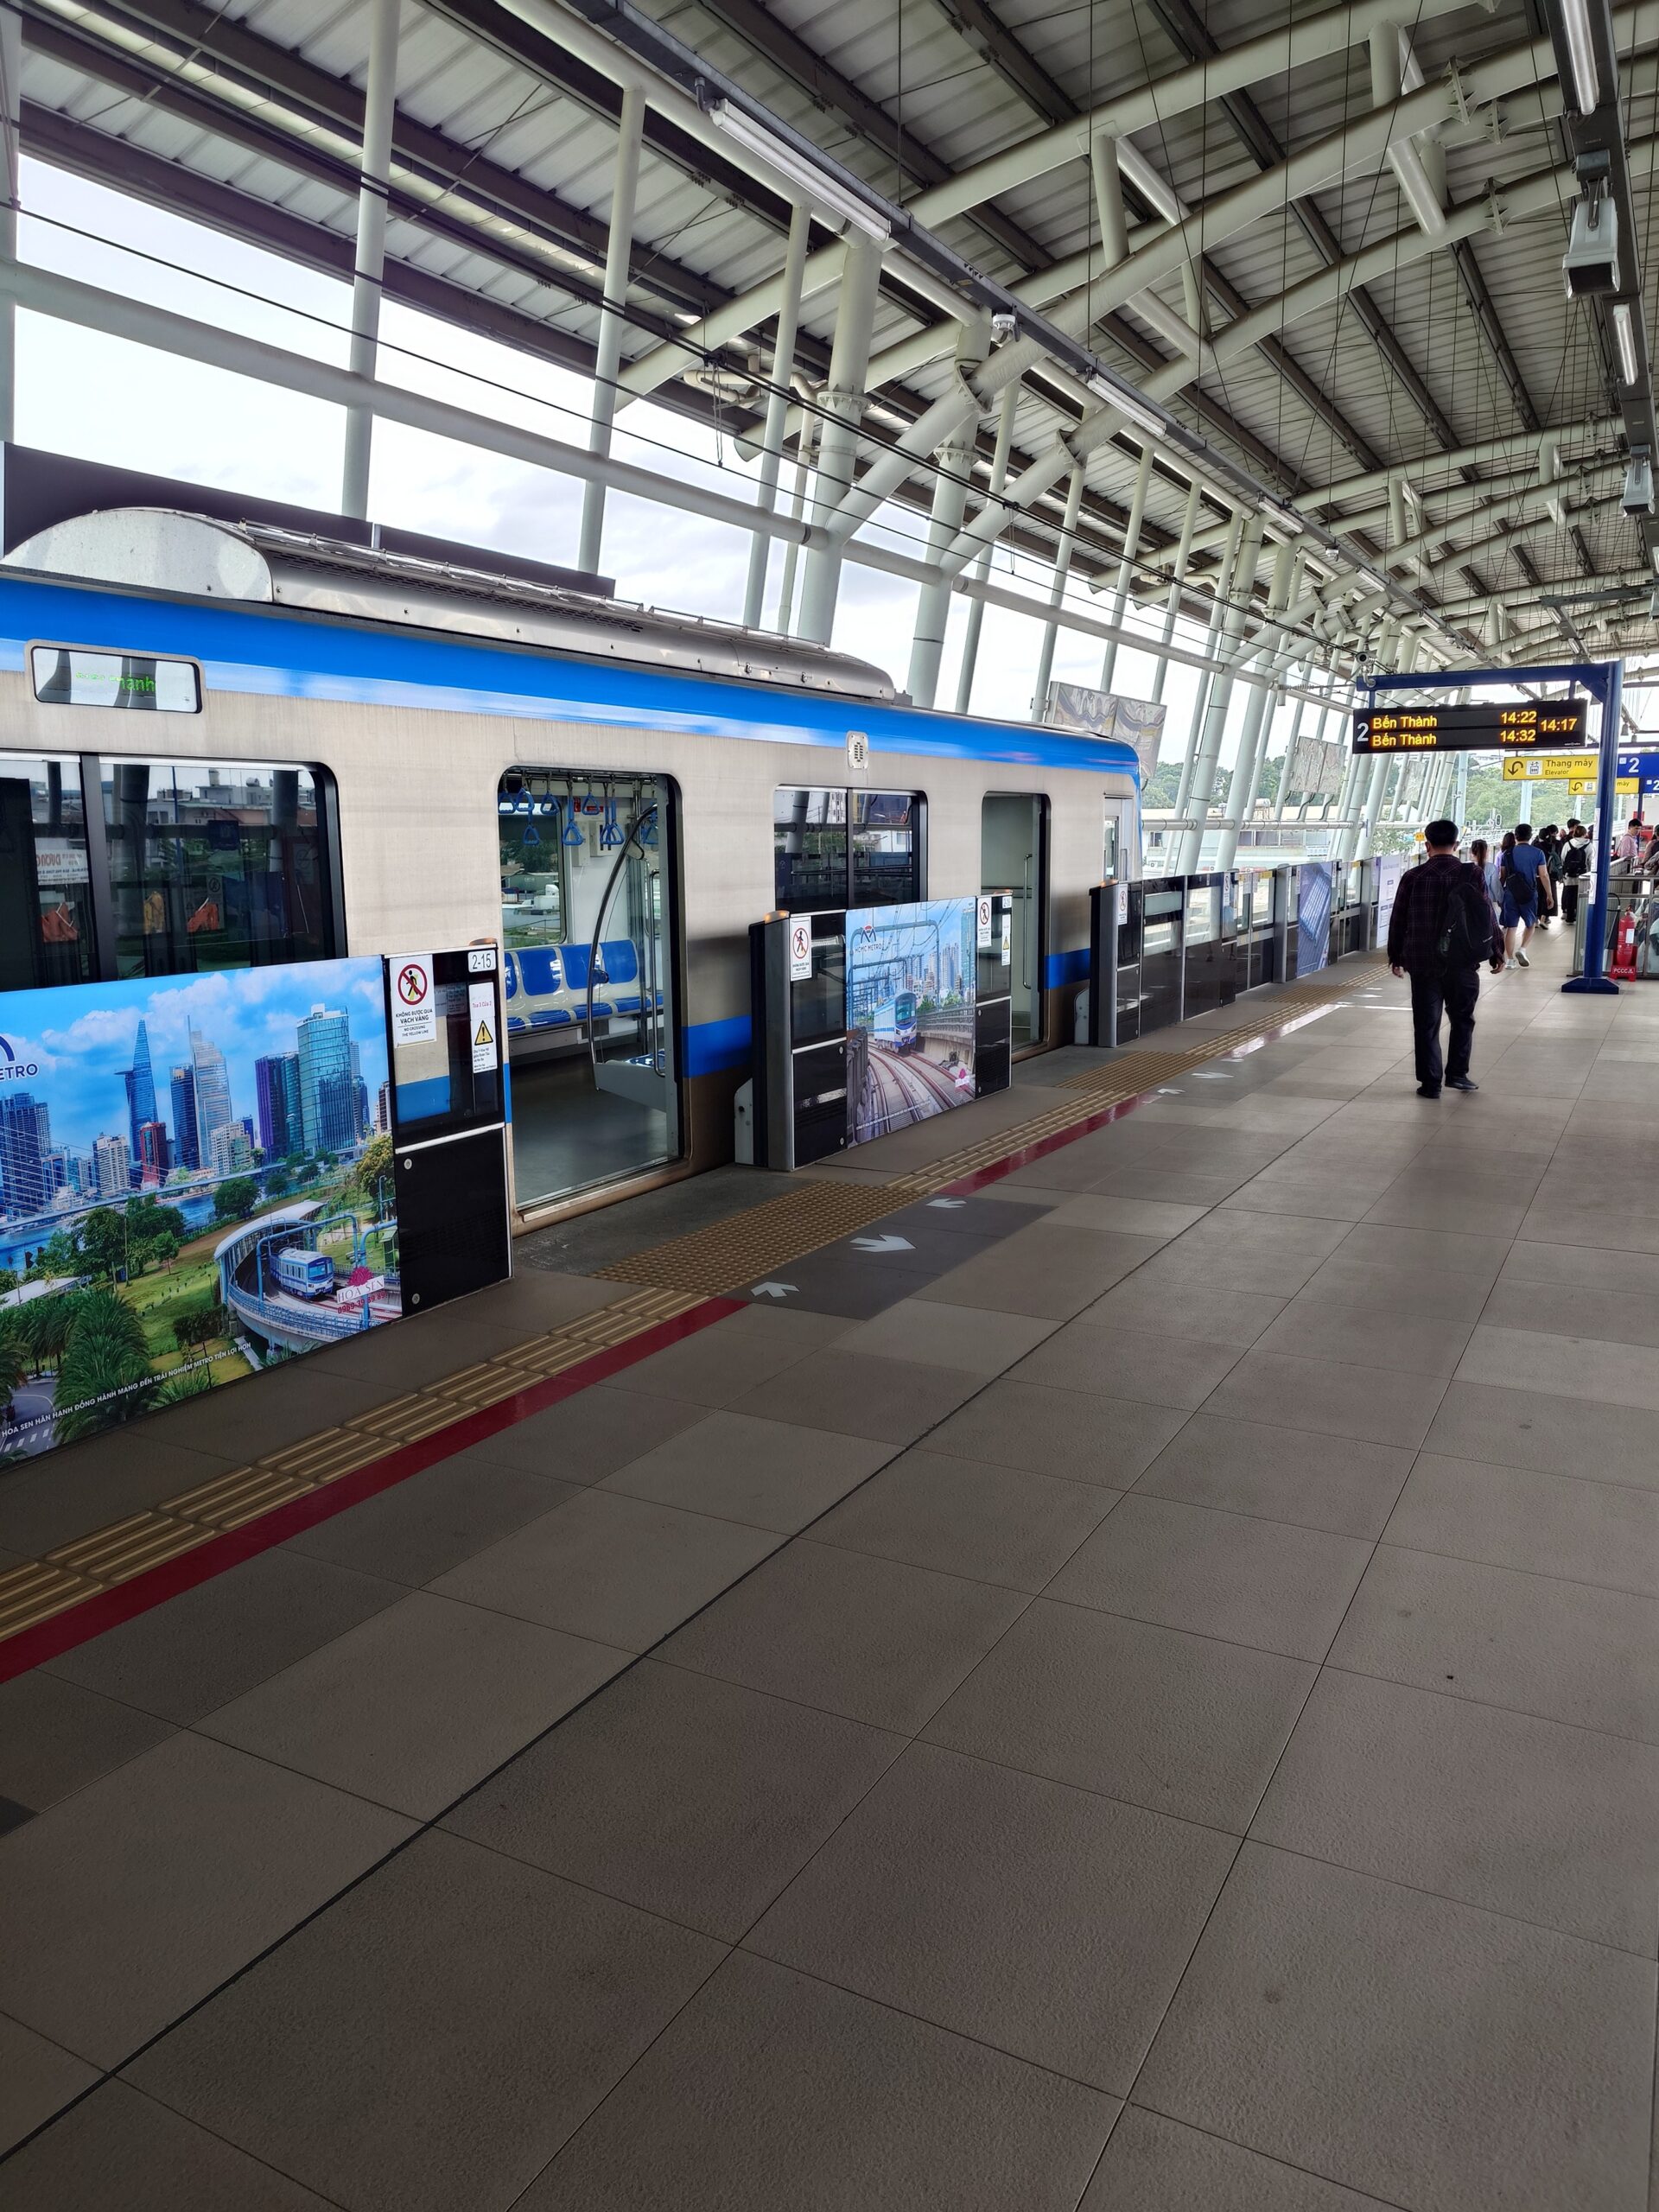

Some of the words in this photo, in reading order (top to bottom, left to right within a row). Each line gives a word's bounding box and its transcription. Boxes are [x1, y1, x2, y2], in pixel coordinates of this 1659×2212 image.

[1372, 715, 1397, 728] Bến
[1400, 715, 1438, 728] Thành
[1501, 710, 1537, 724] 14:22
[1541, 718, 1578, 731] 14:17
[1357, 722, 1370, 741] 2
[1372, 733, 1396, 747] Bến
[1400, 734, 1437, 745] Thành
[1500, 729, 1536, 741] 14:32
[1546, 760, 1572, 768] Thang
[1574, 758, 1593, 767] máy
[1628, 757, 1640, 773] 2
[1652, 779, 1659, 791] 2
[472, 953, 492, 969] 2-15
[400, 1017, 415, 1026] VẠCH
[338, 1287, 361, 1302] HOA
[2, 1427, 19, 1438] HOA
[20, 1420, 34, 1431] SEN
[35, 1414, 51, 1425] HÂN
[74, 1399, 96, 1412] ĐỒNG
[97, 1389, 117, 1403] HÀNH
[118, 1382, 138, 1395] MANG
[139, 1376, 153, 1388] ĐẾN
[153, 1370, 168, 1382] TRẢI
[168, 1362, 193, 1377] NGHIỆM
[194, 1355, 213, 1368] METRO
[214, 1349, 227, 1361] TIỆN
[227, 1346, 238, 1357] LỢI
[238, 1342, 251, 1352] HƠN
